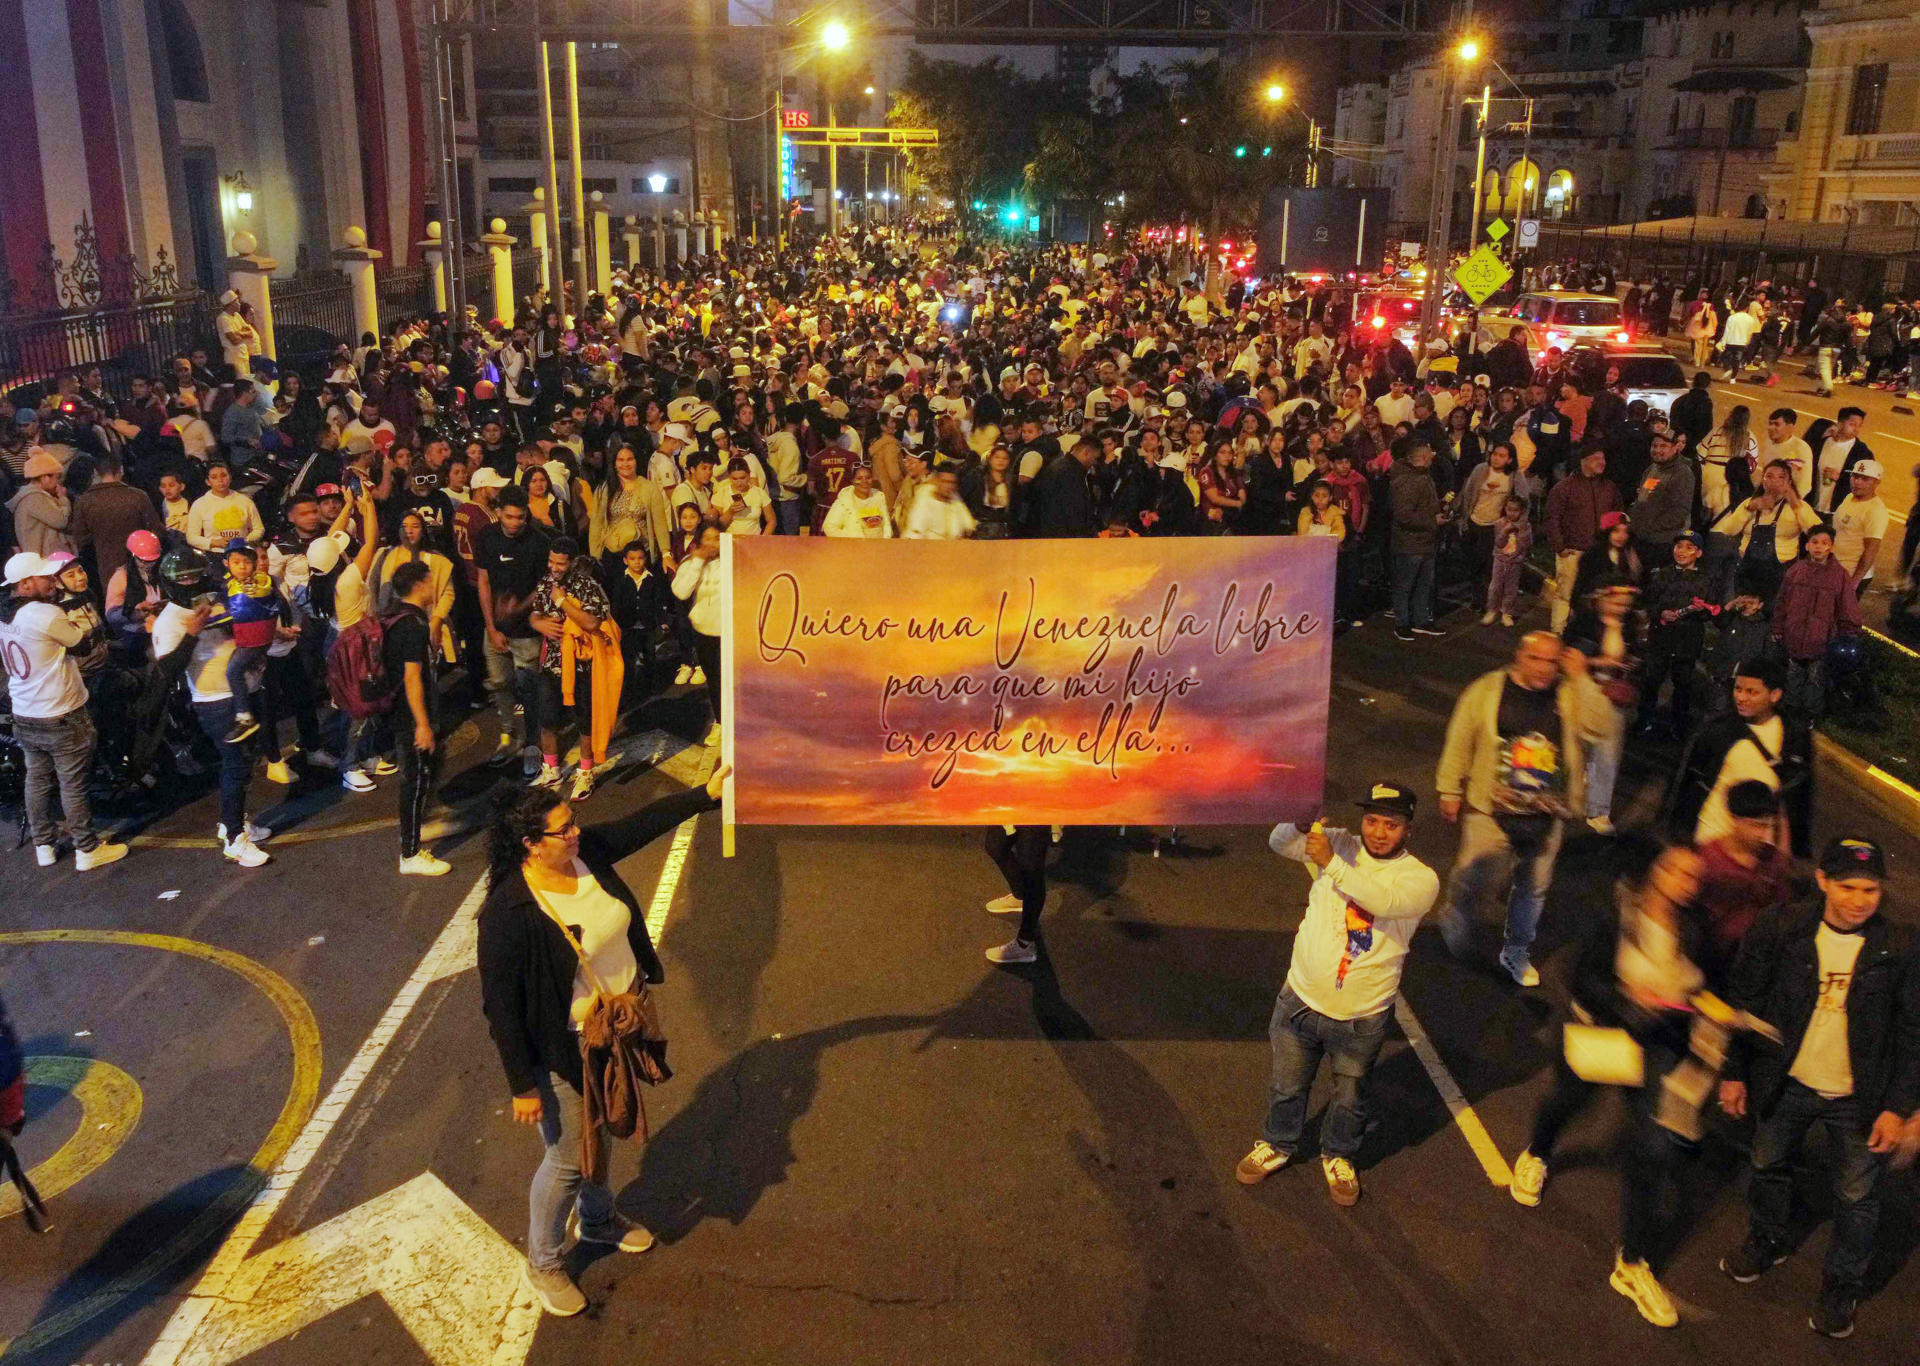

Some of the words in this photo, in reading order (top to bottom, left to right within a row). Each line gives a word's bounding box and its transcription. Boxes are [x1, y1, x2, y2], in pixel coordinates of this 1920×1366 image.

[825, 467, 845, 493] 17
[758, 573, 899, 665] Quiero
[907, 612, 985, 641] una
[994, 577, 1209, 670] Venezuela
[1214, 582, 1319, 655] libre
[881, 673, 982, 730] para
[991, 668, 1054, 729] que
[1063, 673, 1116, 700] mi
[1120, 646, 1201, 729] hijo
[884, 722, 1013, 789] crezca
[1020, 727, 1068, 753] en
[1076, 703, 1192, 780] ella...
